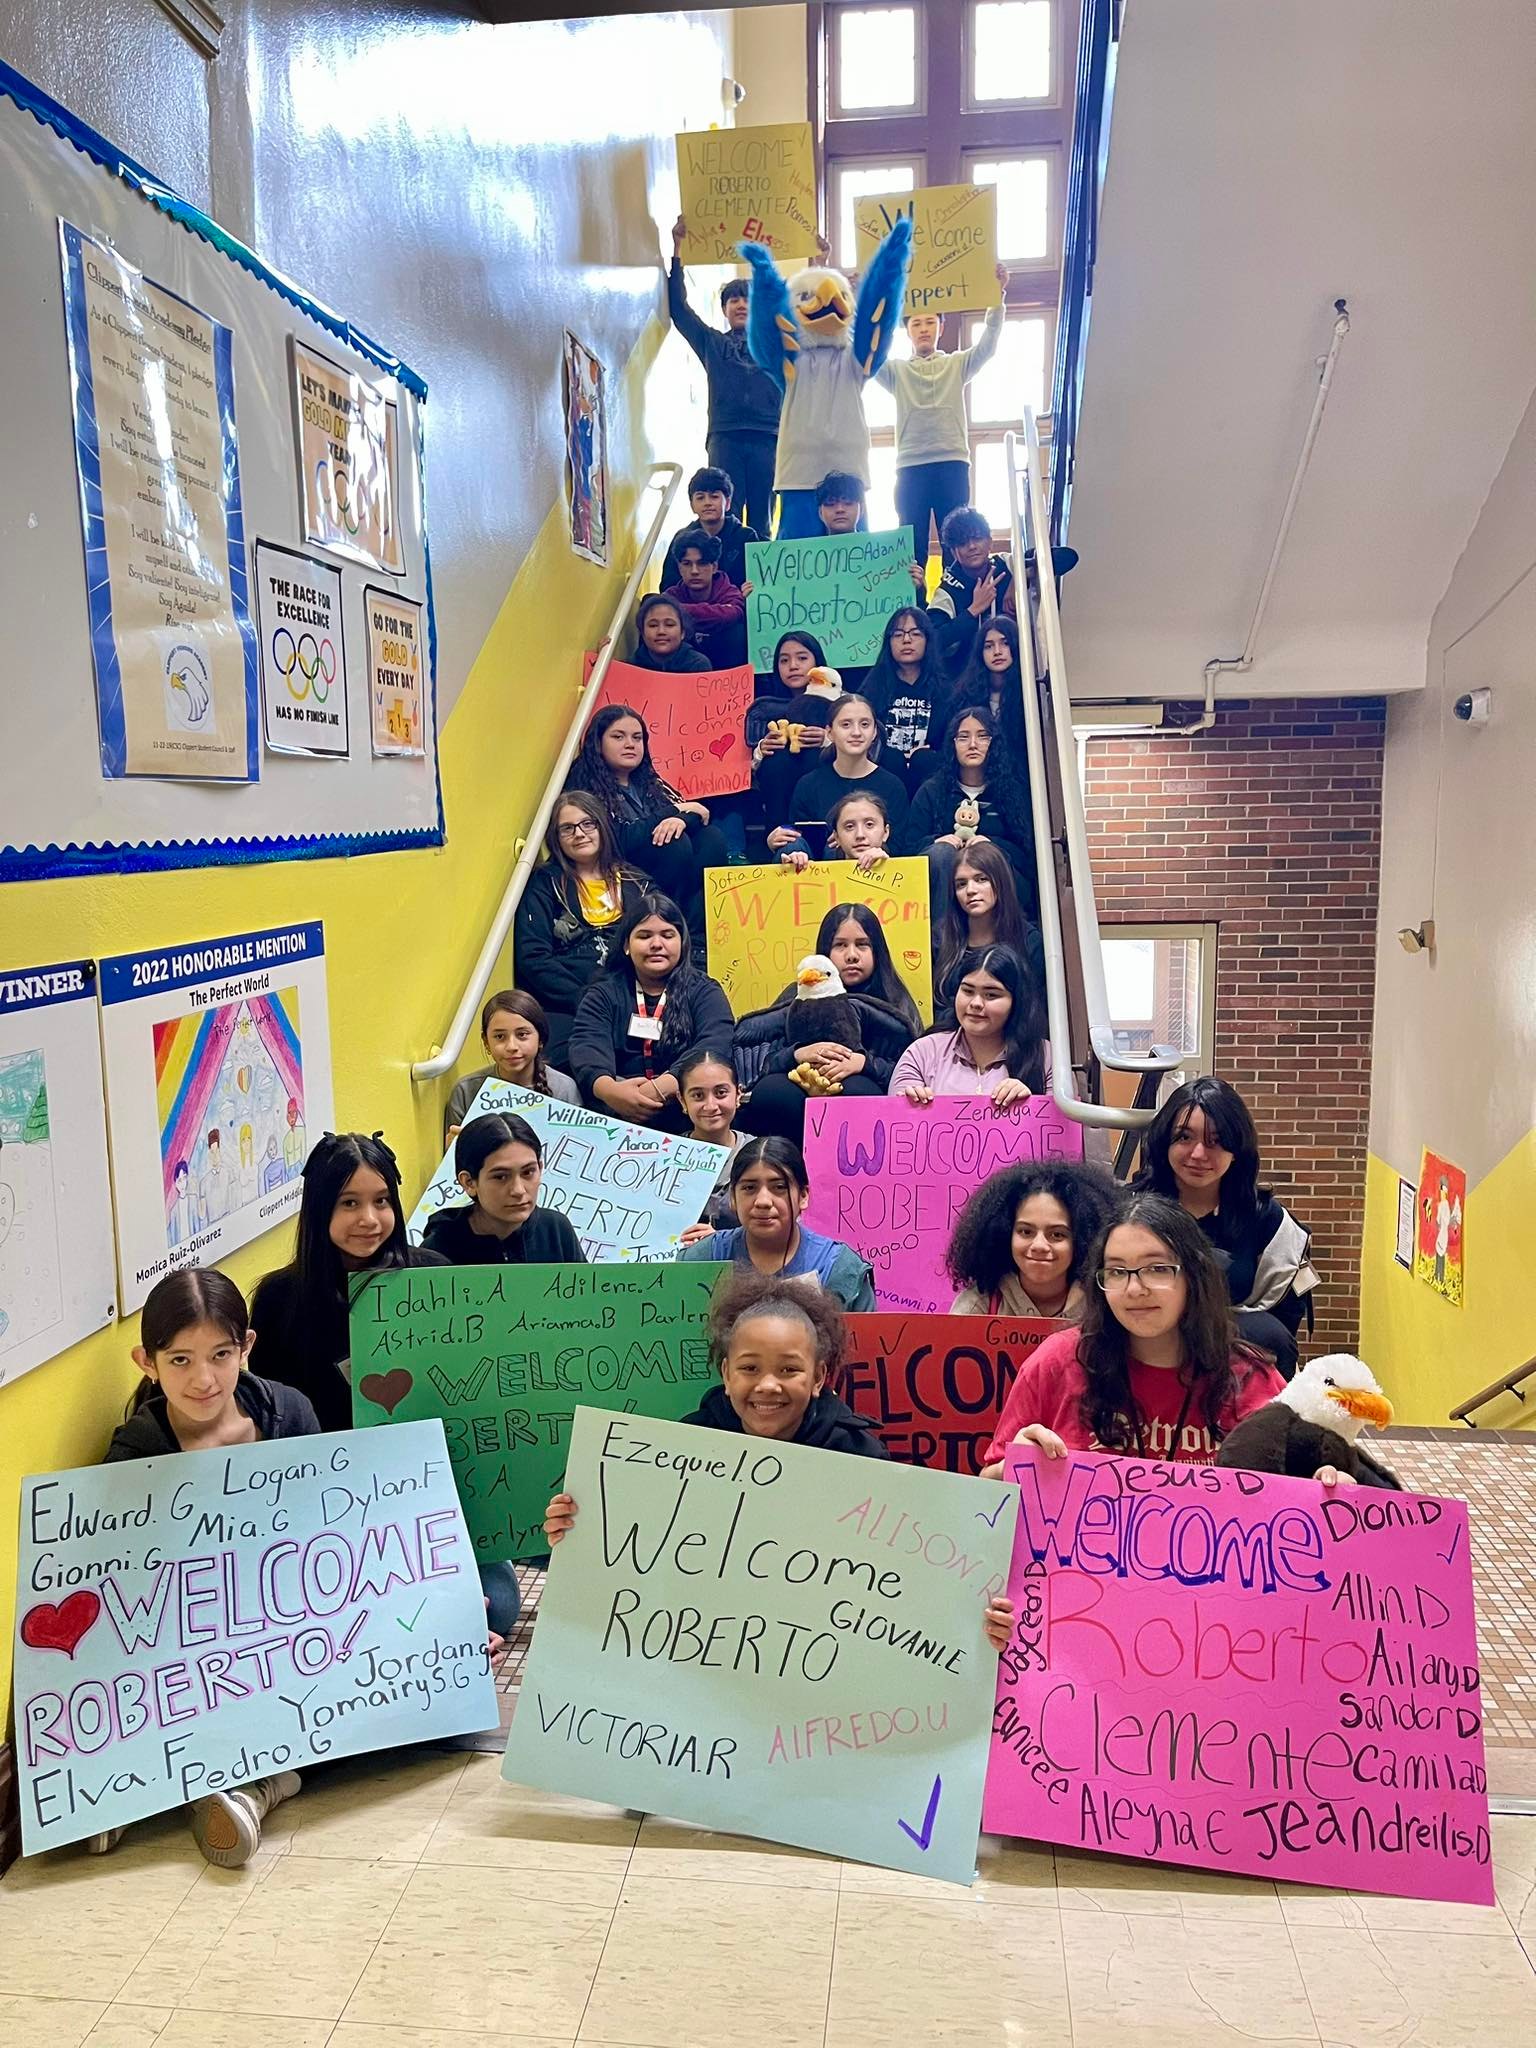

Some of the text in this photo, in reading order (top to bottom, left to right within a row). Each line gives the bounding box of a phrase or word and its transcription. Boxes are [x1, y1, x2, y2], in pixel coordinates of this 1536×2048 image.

[686, 139, 793, 176] WELCOME
[709, 176, 772, 195] ROBERTO
[695, 197, 786, 218] CLEMENTE
[904, 272, 969, 308] ippert
[102, 355, 125, 376] every
[303, 397, 332, 433] GOLD
[328, 389, 352, 415] MAK
[752, 546, 864, 587] Welcome
[269, 577, 331, 610] THE RACE FOR
[757, 583, 864, 633] Roberto
[277, 601, 330, 630] EXCELLENCE
[373, 612, 413, 640] GO FOR THE
[381, 639, 408, 667] GOLD
[377, 667, 414, 691] EVERY DAY
[276, 705, 292, 721] HAS
[293, 708, 304, 722] NO
[306, 710, 328, 724] FINISH
[708, 870, 747, 896] Sofia
[852, 862, 886, 882] Karol
[132, 957, 170, 988] 2022
[171, 942, 254, 979] HONORABLE
[255, 931, 307, 961] MENTION
[189, 973, 270, 1007] The Perfect World
[479, 1090, 545, 1113] Santiago
[546, 1103, 609, 1127] William
[953, 1101, 1051, 1126] Zendaya Z
[618, 1135, 659, 1152] Aaron
[259, 1198, 284, 1219] Clippert
[838, 1184, 981, 1234] ROBER
[136, 1227, 223, 1284] Monica Ruiz-Olivarez
[371, 1314, 485, 1356] Astrid.B
[427, 1338, 713, 1407] WELCOME
[601, 1420, 783, 1488] Ezequiel.O
[320, 1460, 445, 1528] Dylan.F
[599, 1460, 902, 1600] Welcome
[1013, 1462, 1443, 1594] Welcome Dioni.D
[98, 1508, 461, 1656] WELCOME
[1331, 1571, 1451, 1630] Allin.D
[601, 1588, 840, 1683] ROBERTO
[1046, 1569, 1369, 1685] Roberto
[537, 1693, 738, 1780] VICTORIA.R
[1039, 1682, 1356, 1802] Clemente
